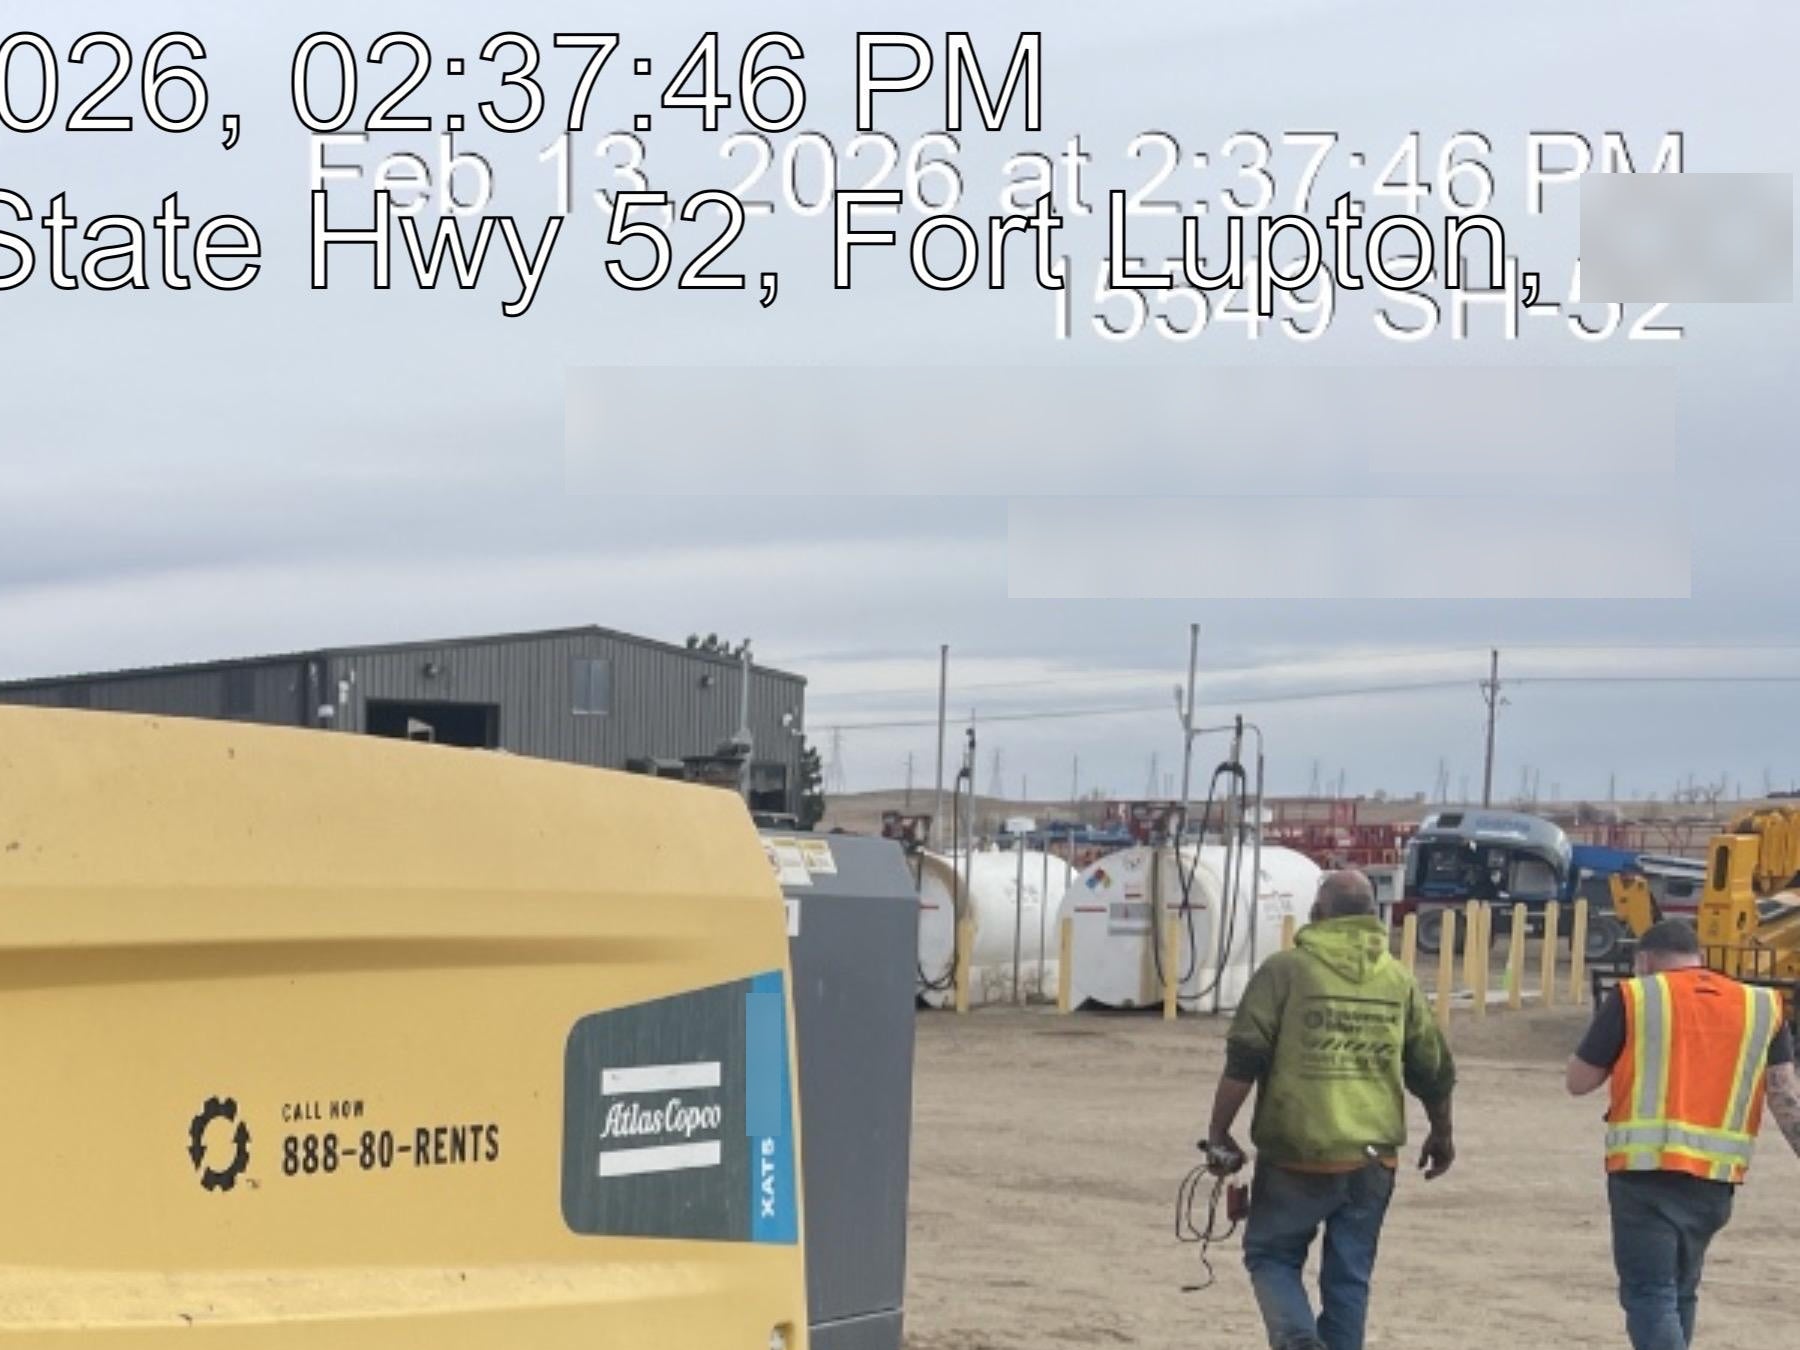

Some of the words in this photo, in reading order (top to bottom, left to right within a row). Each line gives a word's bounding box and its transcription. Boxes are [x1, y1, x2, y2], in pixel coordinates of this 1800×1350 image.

[282, 1103, 322, 1123] CALL
[329, 1100, 365, 1120] NOW
[282, 1124, 499, 1177] 888-80-RENTS
